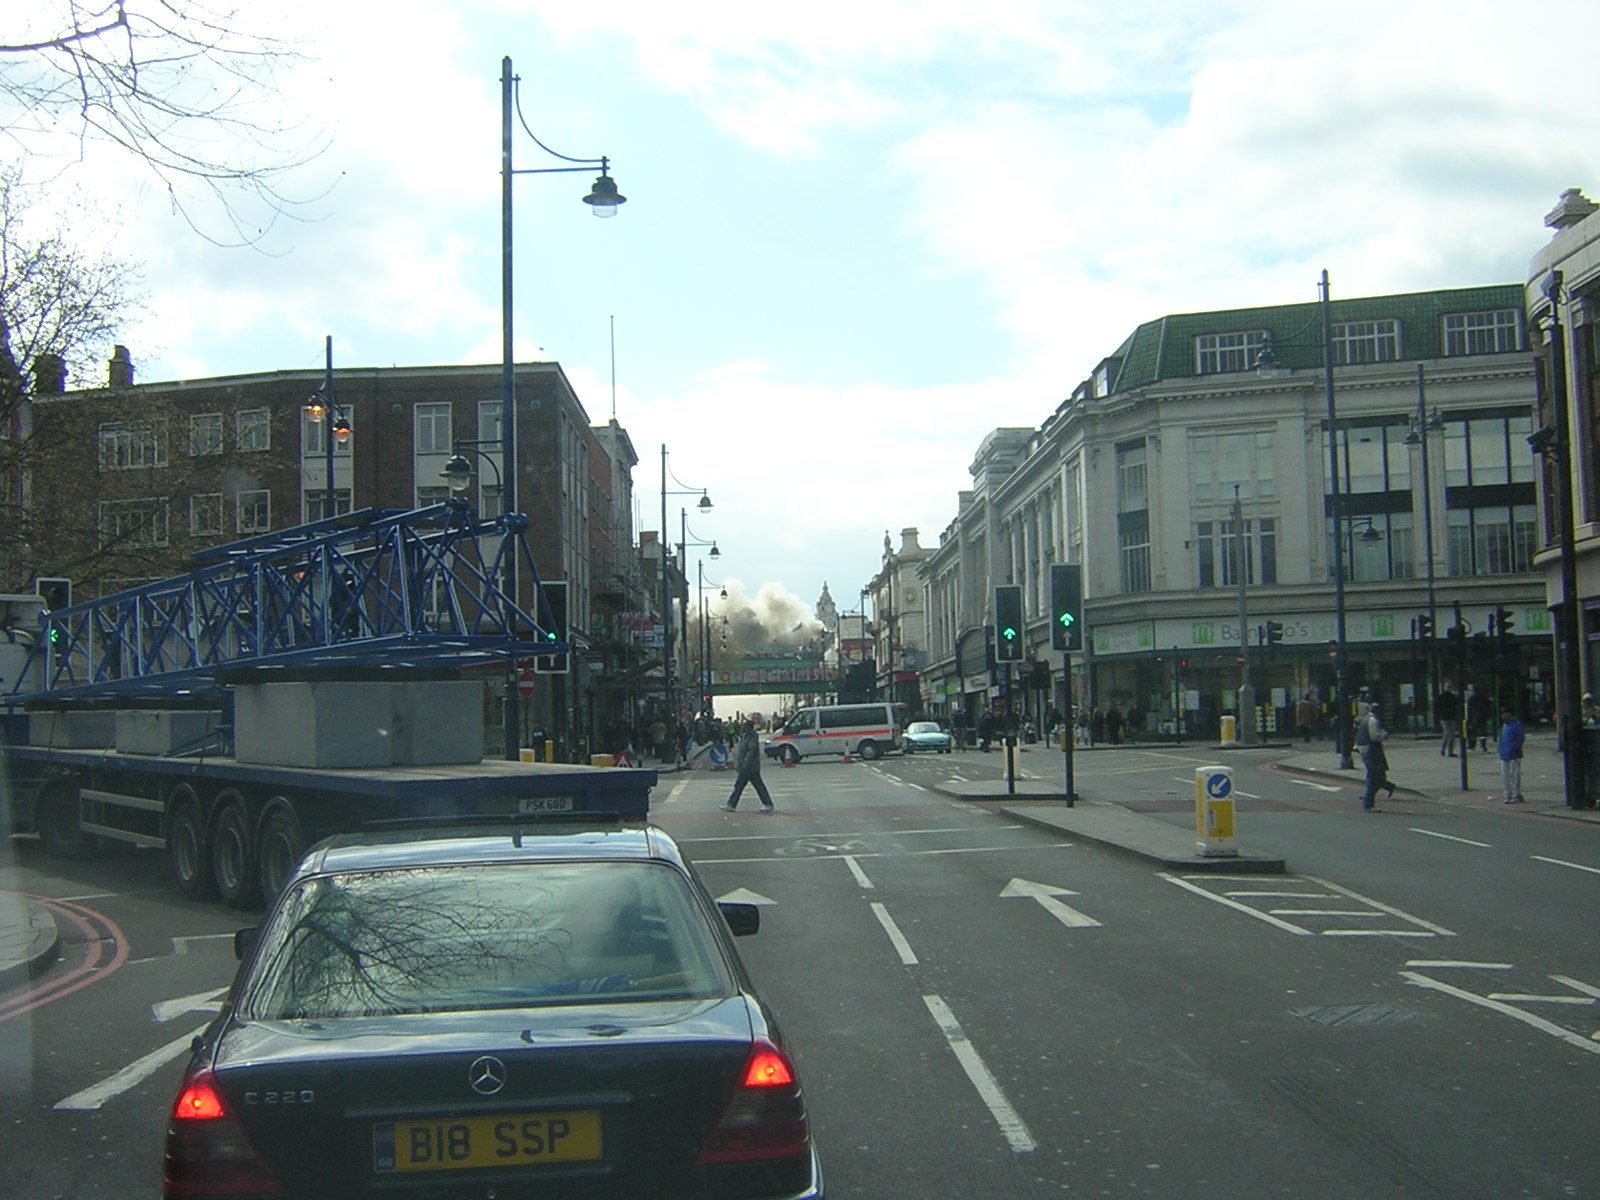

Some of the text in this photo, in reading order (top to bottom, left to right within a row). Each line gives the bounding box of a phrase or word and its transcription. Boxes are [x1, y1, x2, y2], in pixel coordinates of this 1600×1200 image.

[1321, 623, 1364, 636] stre
[526, 800, 545, 810] PSK
[245, 1090, 314, 1104] C 220
[409, 1118, 570, 1163] B18 SSP
[379, 1158, 393, 1167] GB
